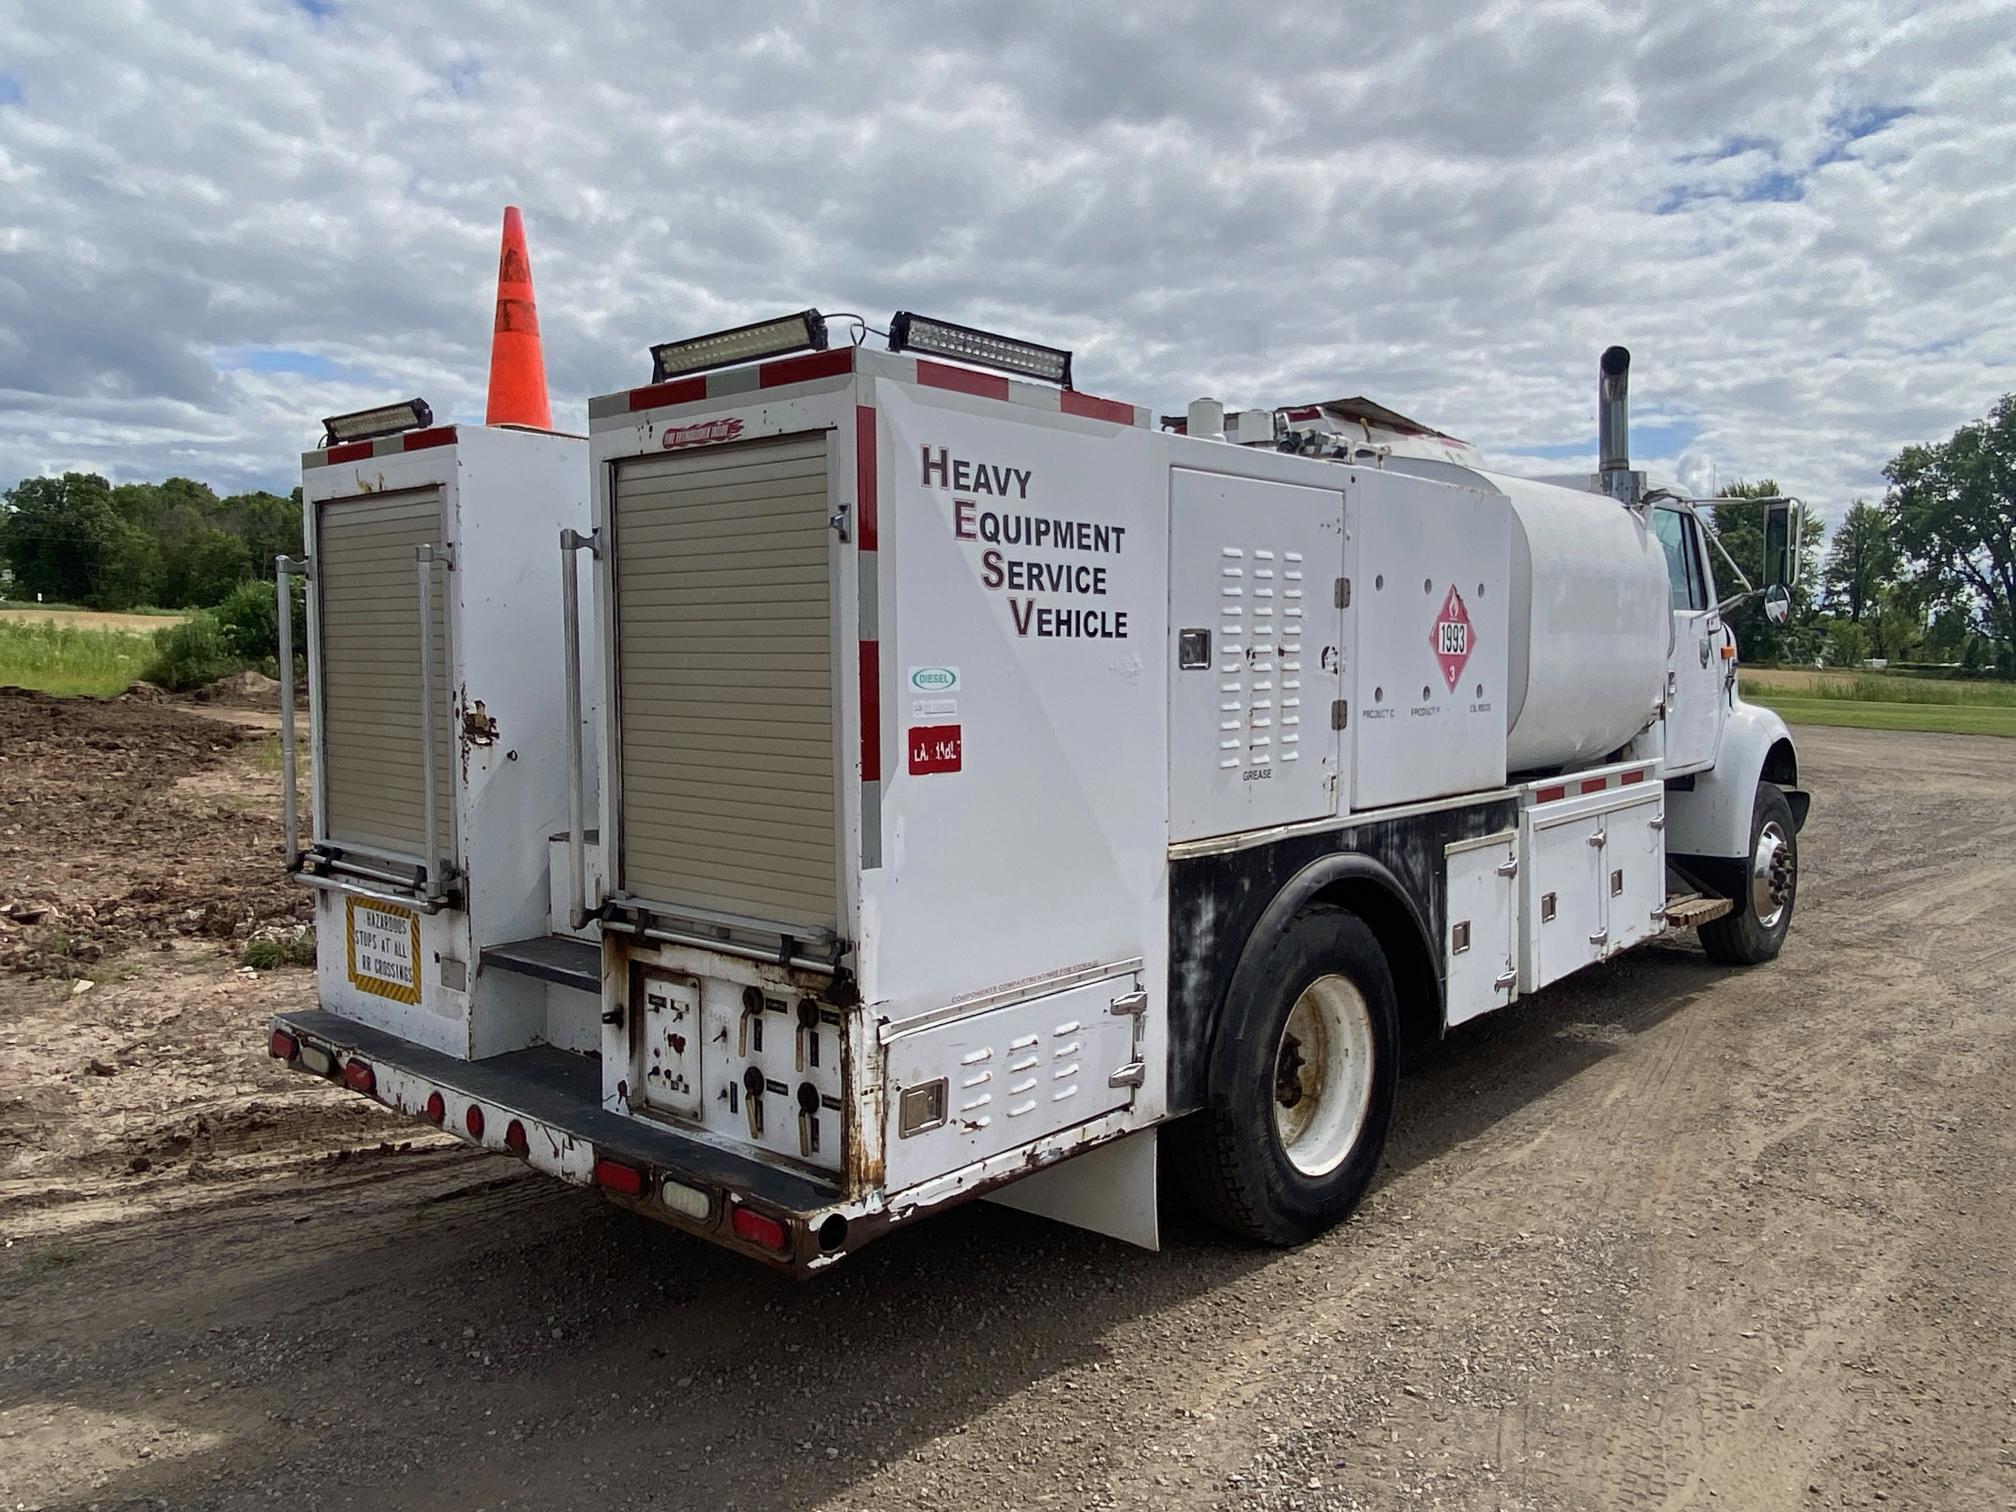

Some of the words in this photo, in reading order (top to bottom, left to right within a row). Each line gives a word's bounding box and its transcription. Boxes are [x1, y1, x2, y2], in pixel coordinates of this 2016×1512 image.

[920, 443, 1032, 499] HEAVY
[953, 497, 1126, 554] EQUIPMENT
[981, 548, 1107, 596] SERVICE
[1007, 596, 1129, 640] VEHICLE
[1441, 623, 1465, 653] 1993
[919, 673, 949, 684] DIESEL
[1449, 665, 1456, 682] 3
[1243, 768, 1272, 781] GREASE
[366, 911, 407, 935] HAZARDOUS
[355, 930, 377, 950] STOPS
[381, 938, 391, 954] AT
[394, 941, 407, 959] ALL
[362, 954, 372, 972] RR
[374, 958, 413, 983] CROSSINGS
